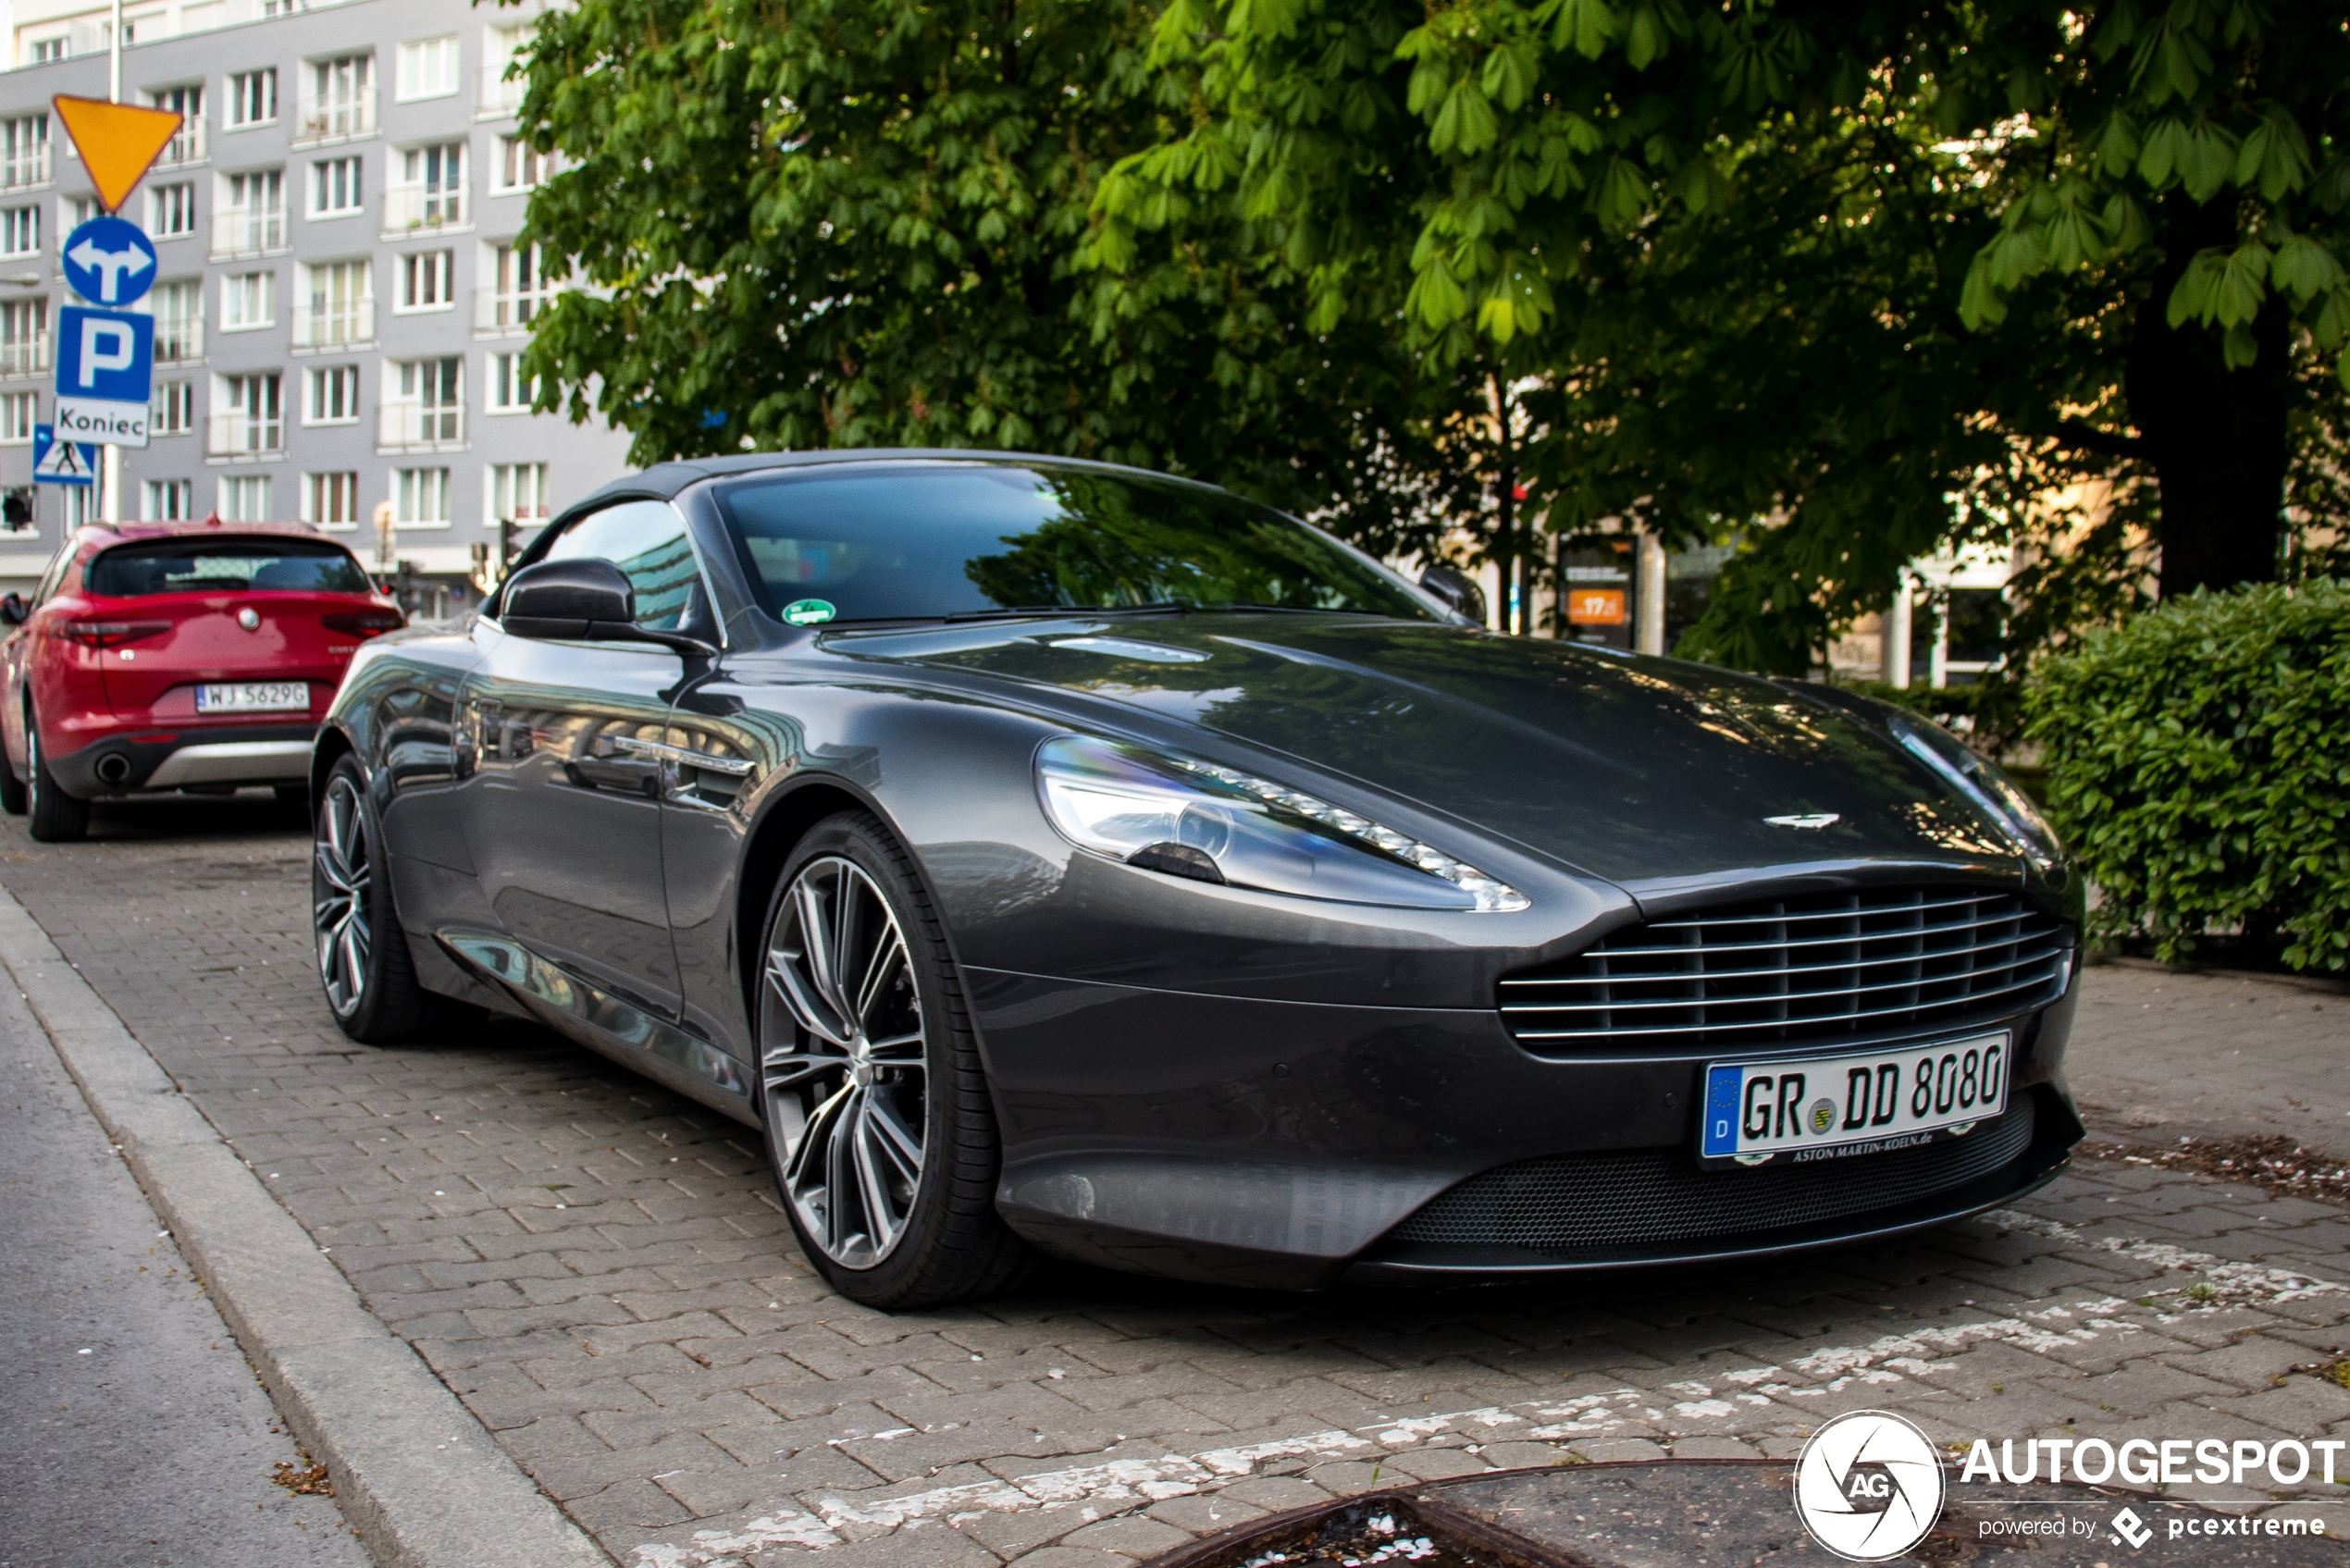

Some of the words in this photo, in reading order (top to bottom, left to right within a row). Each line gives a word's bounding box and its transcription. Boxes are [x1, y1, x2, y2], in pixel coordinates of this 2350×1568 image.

[79, 317, 135, 388] P
[59, 407, 144, 436] Koniec
[244, 684, 305, 704] 5629G
[1742, 1073, 1806, 1141] GR
[1841, 1064, 1899, 1131] DD
[1911, 1044, 2001, 1119] 8080
[1716, 1120, 1728, 1139] D
[1793, 1148, 1835, 1163] ASTON
[1836, 1132, 1933, 1160] MARTIN-KOELN.de
